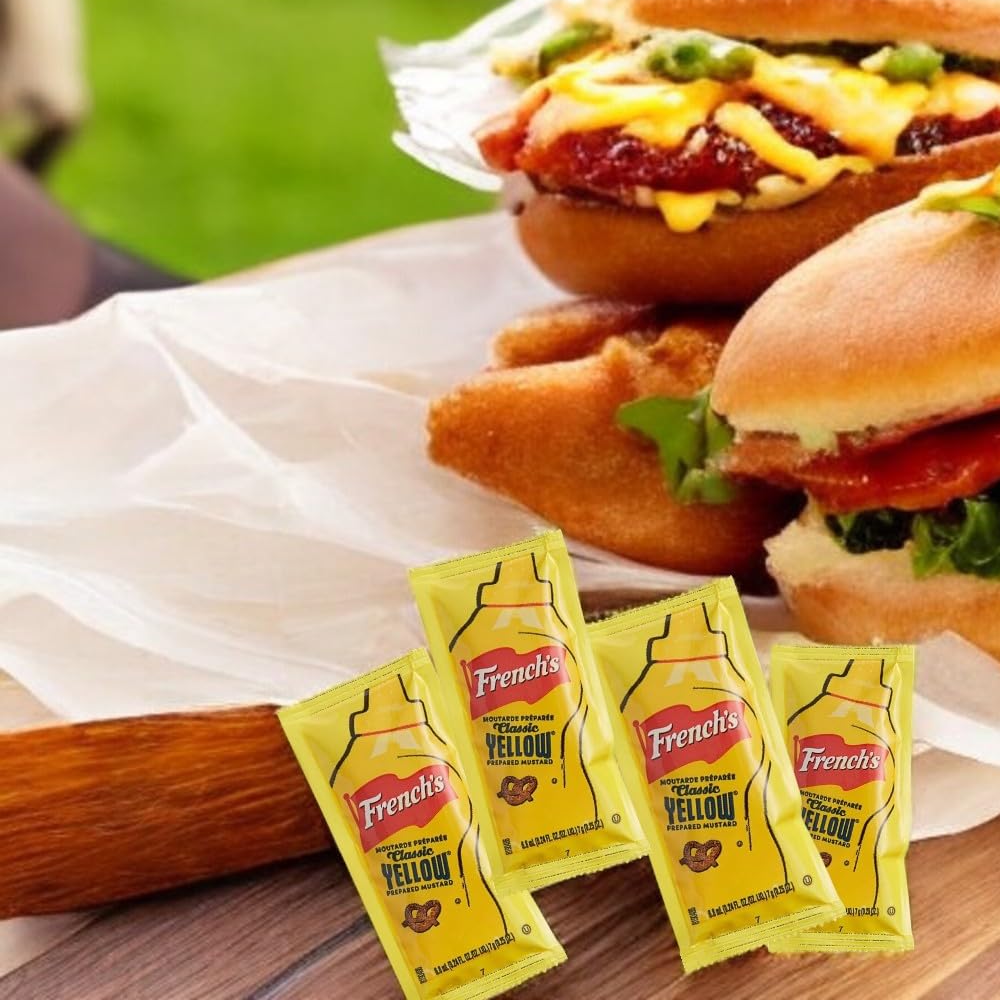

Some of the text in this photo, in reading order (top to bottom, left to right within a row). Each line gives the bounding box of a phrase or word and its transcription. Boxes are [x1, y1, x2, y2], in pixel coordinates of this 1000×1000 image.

[473, 654, 561, 698] French's
[493, 722, 539, 734] Classic
[648, 707, 739, 760] French's
[486, 731, 551, 759] YELLOW
[799, 747, 882, 772] French's
[660, 776, 698, 786] MOUTARDE
[671, 783, 720, 796] Classic
[358, 773, 445, 830] French's
[664, 791, 735, 825] YELLOW
[806, 798, 847, 817] Classic
[667, 820, 737, 831] PREPARED MUSTARD
[375, 842, 412, 854] MOUTARDE
[387, 846, 434, 862] Classic
[381, 852, 451, 890] YELLOW
[386, 879, 453, 896] PREPARED MUSTARD
